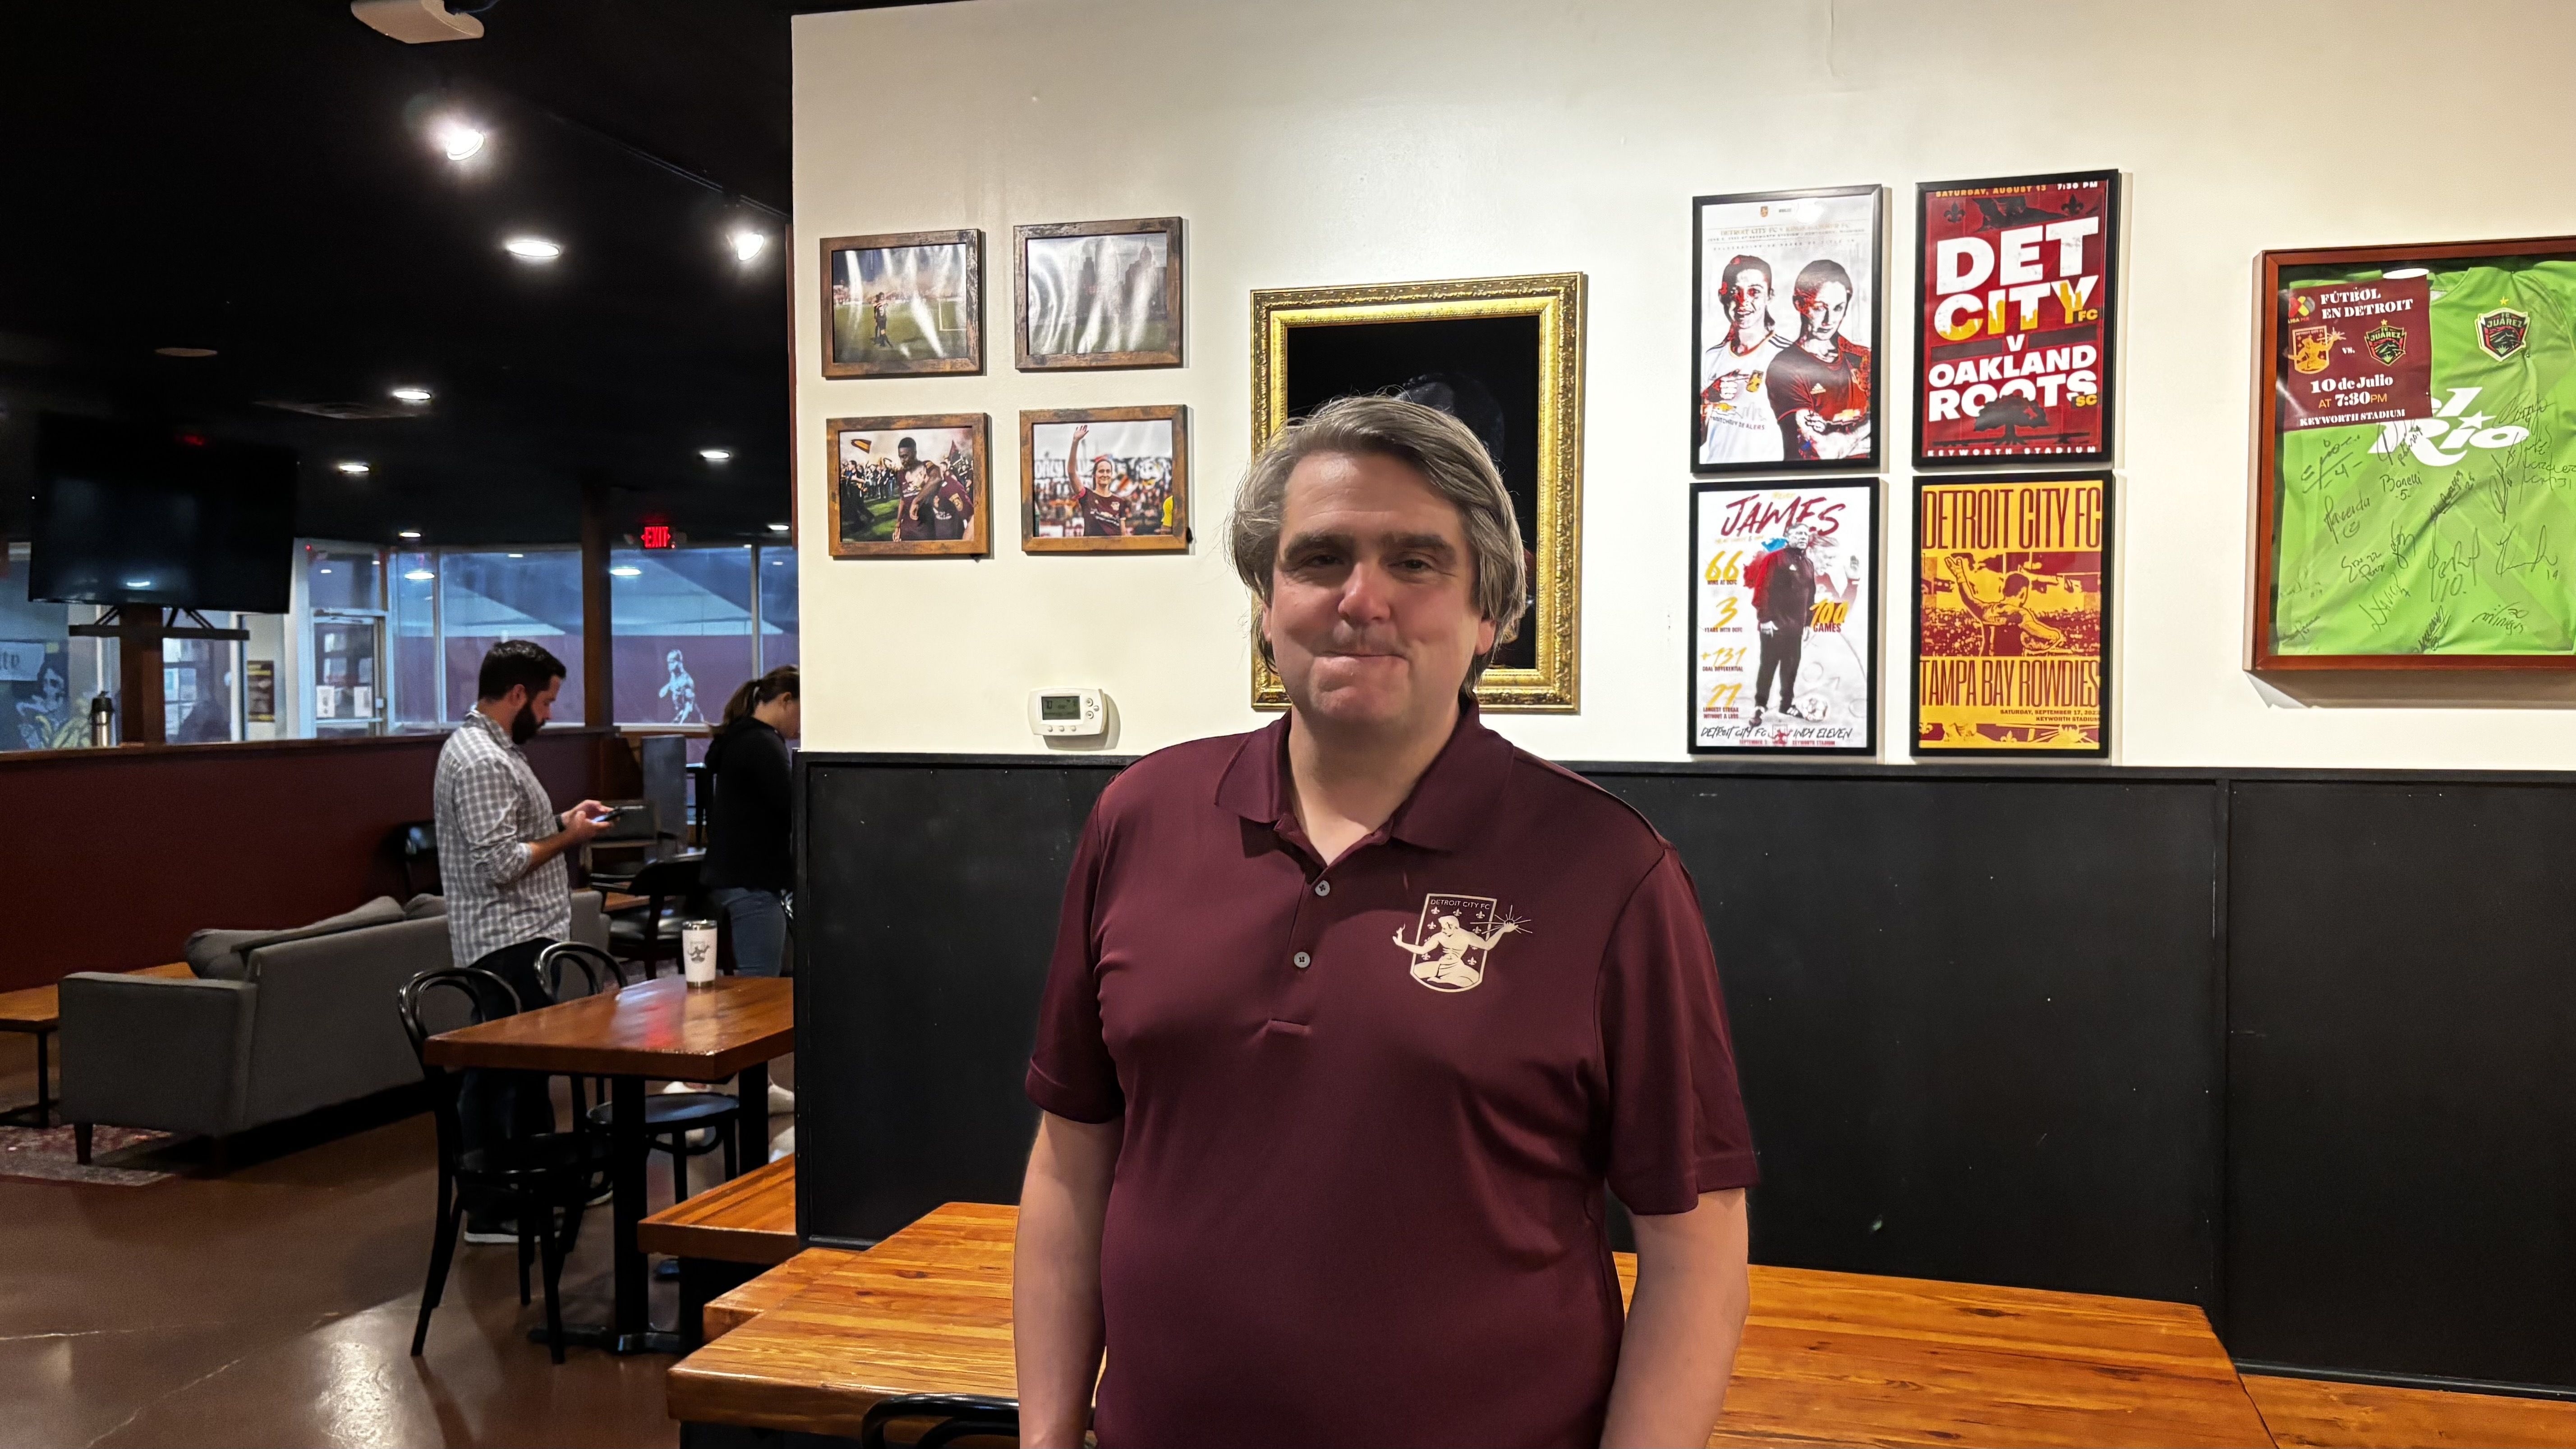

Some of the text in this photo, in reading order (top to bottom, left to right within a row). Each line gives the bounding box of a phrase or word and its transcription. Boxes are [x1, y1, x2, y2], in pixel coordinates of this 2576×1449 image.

[1936, 189, 1989, 198] SATURDAY,
[1992, 185, 2032, 194] AUGUST
[2057, 182, 2079, 190] 7:30
[1937, 216, 2099, 295] DET
[1934, 275, 2099, 341] CITY
[2078, 309, 2098, 322] FC
[2322, 299, 2413, 319] EN DETROIT
[1929, 345, 2097, 387] OAKLAND
[2310, 374, 2393, 394] 10 de Julio
[1929, 370, 2097, 422] ROOTS
[2076, 395, 2098, 407] SC
[2318, 399, 2332, 409] AT
[2300, 409, 2406, 426] KEYWORTH STADIUM
[1927, 446, 2096, 457] KEYWORTH STADIUM
[1720, 493, 1846, 537] JAMES
[1922, 487, 2101, 550] DETROIT CITY FC
[644, 526, 669, 549] EXIT
[1705, 550, 1743, 580] 66
[1716, 596, 1738, 629] 3
[1813, 622, 1841, 633] GAMES
[1920, 659, 2100, 708] TAMPA BAY ROWDIES
[1701, 726, 1767, 739] DETROIT CITY FC
[1793, 728, 1815, 740] INDY
